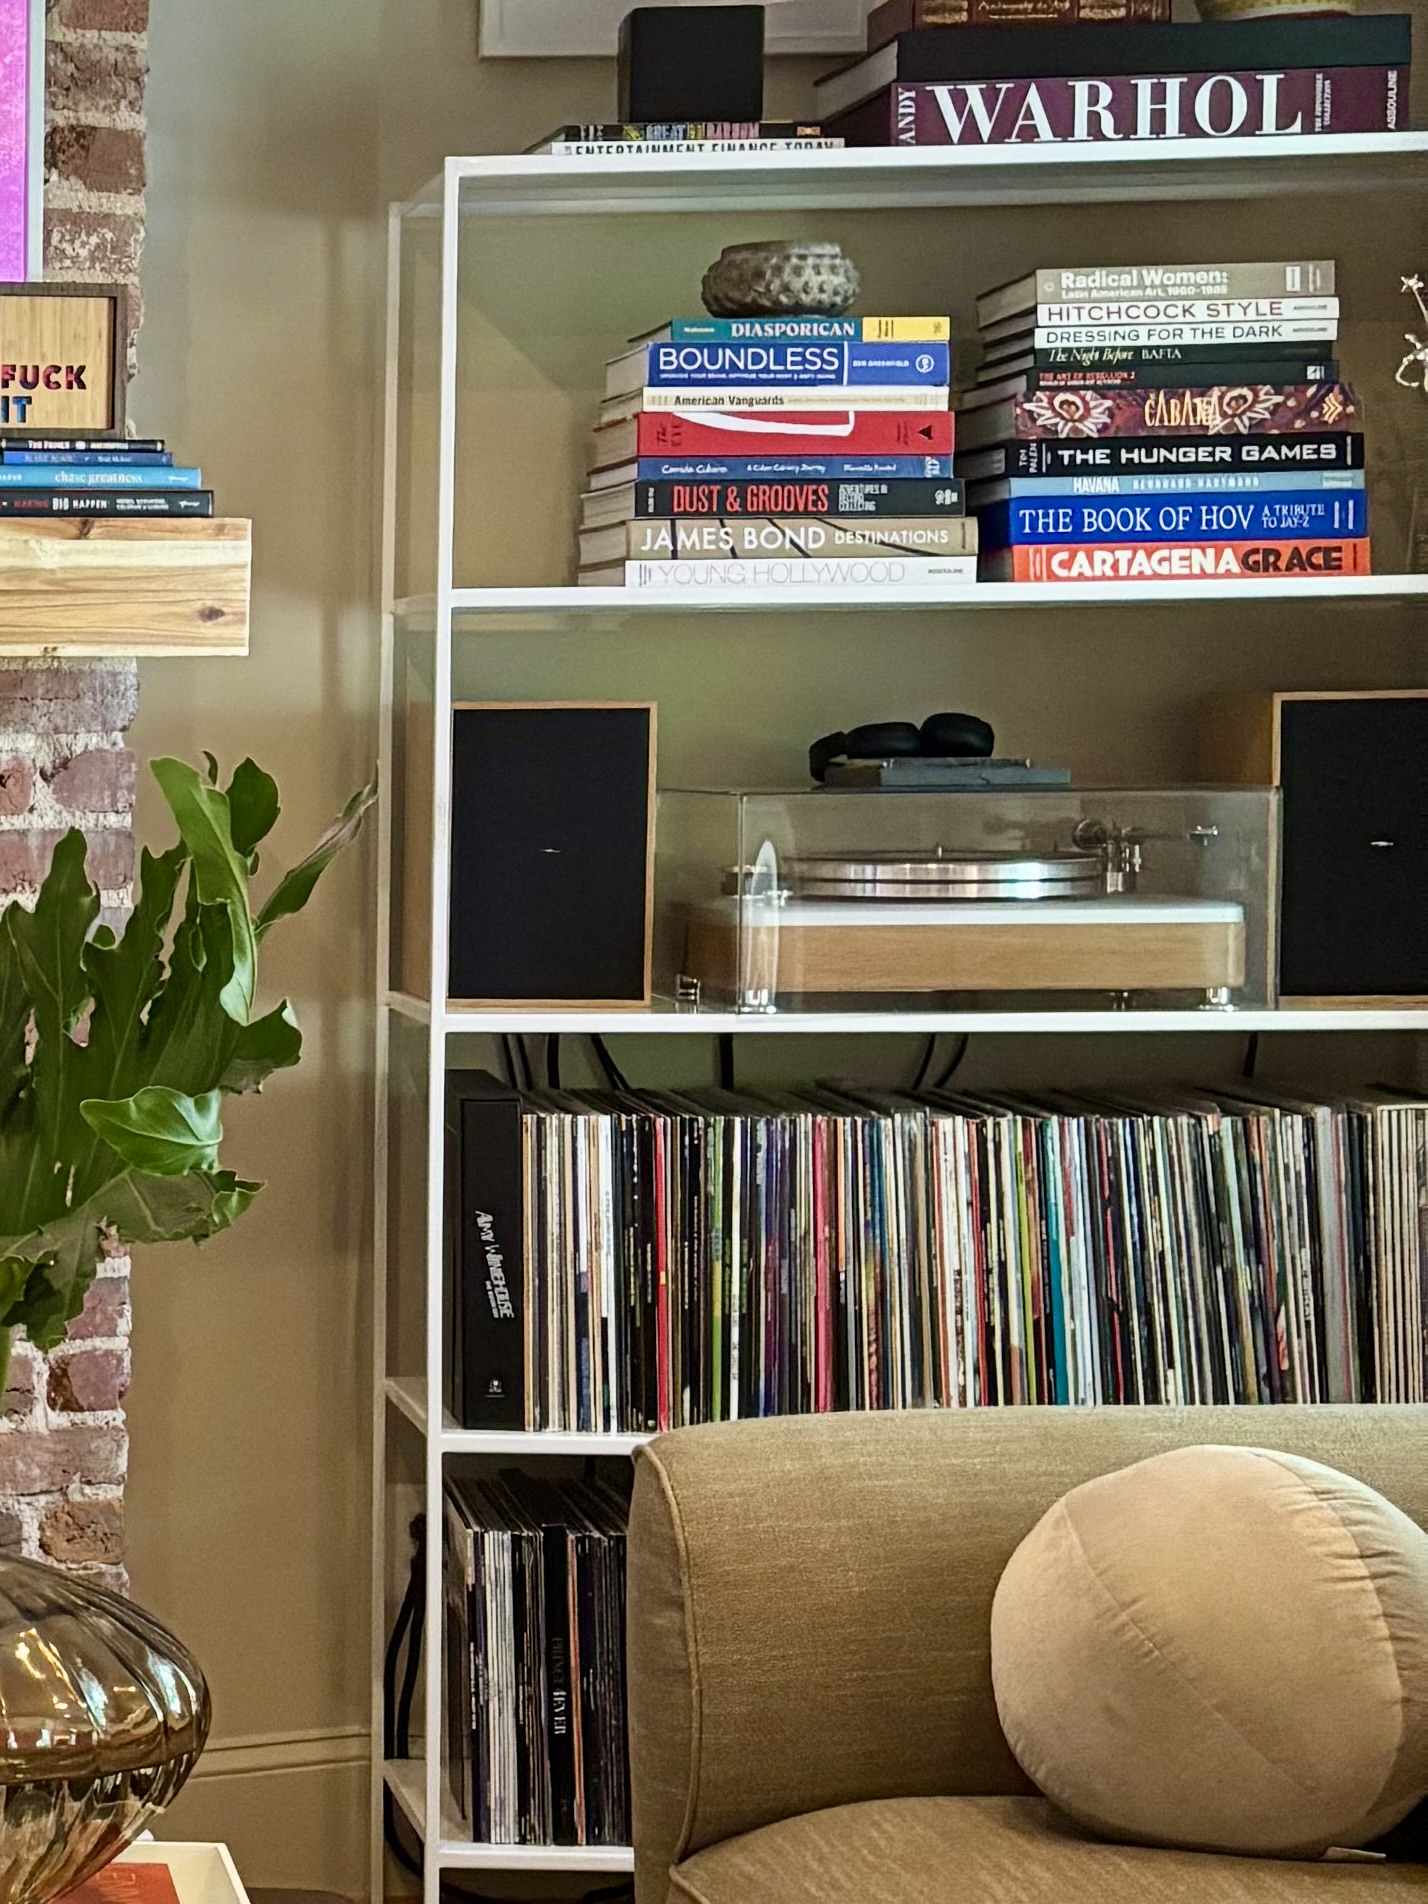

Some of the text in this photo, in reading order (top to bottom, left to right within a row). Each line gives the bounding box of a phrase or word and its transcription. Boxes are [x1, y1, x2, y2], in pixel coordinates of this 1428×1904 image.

[898, 87, 916, 144] ANDY
[925, 73, 1303, 143] WARHOL
[1061, 269, 1228, 289] Radical Women:
[1061, 289, 1088, 299] Latin
[1090, 287, 1143, 298] American
[1048, 301, 1284, 322] HITCHCOCK STYLE
[731, 322, 855, 337] DIASPORICAN
[1047, 329, 1140, 343] DRESSING
[1147, 328, 1184, 341] FOR
[1190, 327, 1225, 339] THE
[1232, 325, 1283, 339] DARK
[659, 347, 839, 371] BOUNDLESS
[1049, 348, 1182, 366] The Night Before BAFTA
[0, 364, 87, 390] FUCK
[0, 395, 33, 424] IT
[674, 395, 725, 406] American
[728, 395, 784, 408] Vanguards
[1144, 390, 1220, 427] CABANA
[1057, 443, 1337, 465] THE HUNGER GAMES
[1073, 476, 1120, 494] HAVANA
[72, 499, 107, 509] HAPPEN
[673, 485, 719, 513] DUST
[726, 484, 741, 512] &
[746, 484, 829, 512] GROOVES
[1263, 503, 1325, 516] A TRIBUTE
[1019, 504, 1254, 533] THE BOOK OF HOV
[1261, 516, 1277, 528] TO
[641, 527, 949, 551] JAMES BOND DESTINATIONS
[1051, 546, 1343, 577] CARTAGENA GRACE
[659, 562, 906, 585] YOUNG HOLLYWOOD
[475, 1210, 495, 1242] AMY
[485, 1244, 515, 1319] WINEHOUSE
